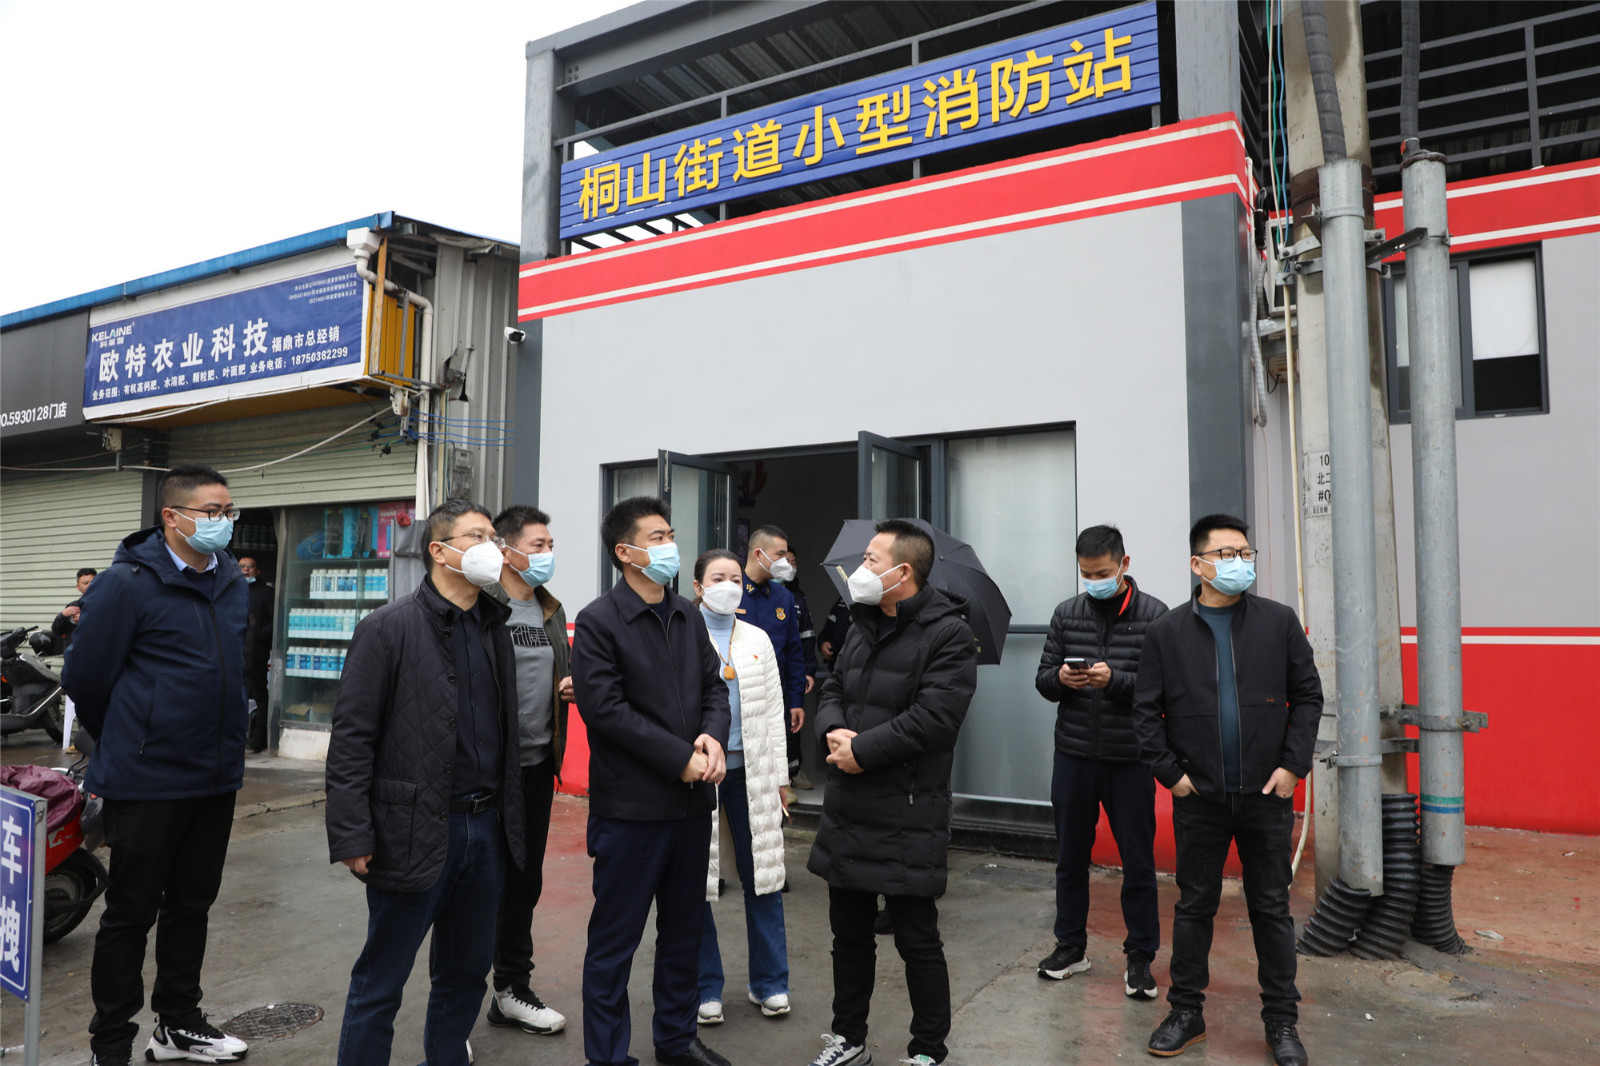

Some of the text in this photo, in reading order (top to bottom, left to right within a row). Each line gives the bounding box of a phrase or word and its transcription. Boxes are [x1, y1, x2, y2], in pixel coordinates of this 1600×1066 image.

[579, 27, 1133, 220] 桐山街道小型消防站
[99, 317, 269, 383] 欧特农业科技
[271, 325, 340, 353] 福鼎市总经销
[0, 401, 67, 428] 0.5930128门店
